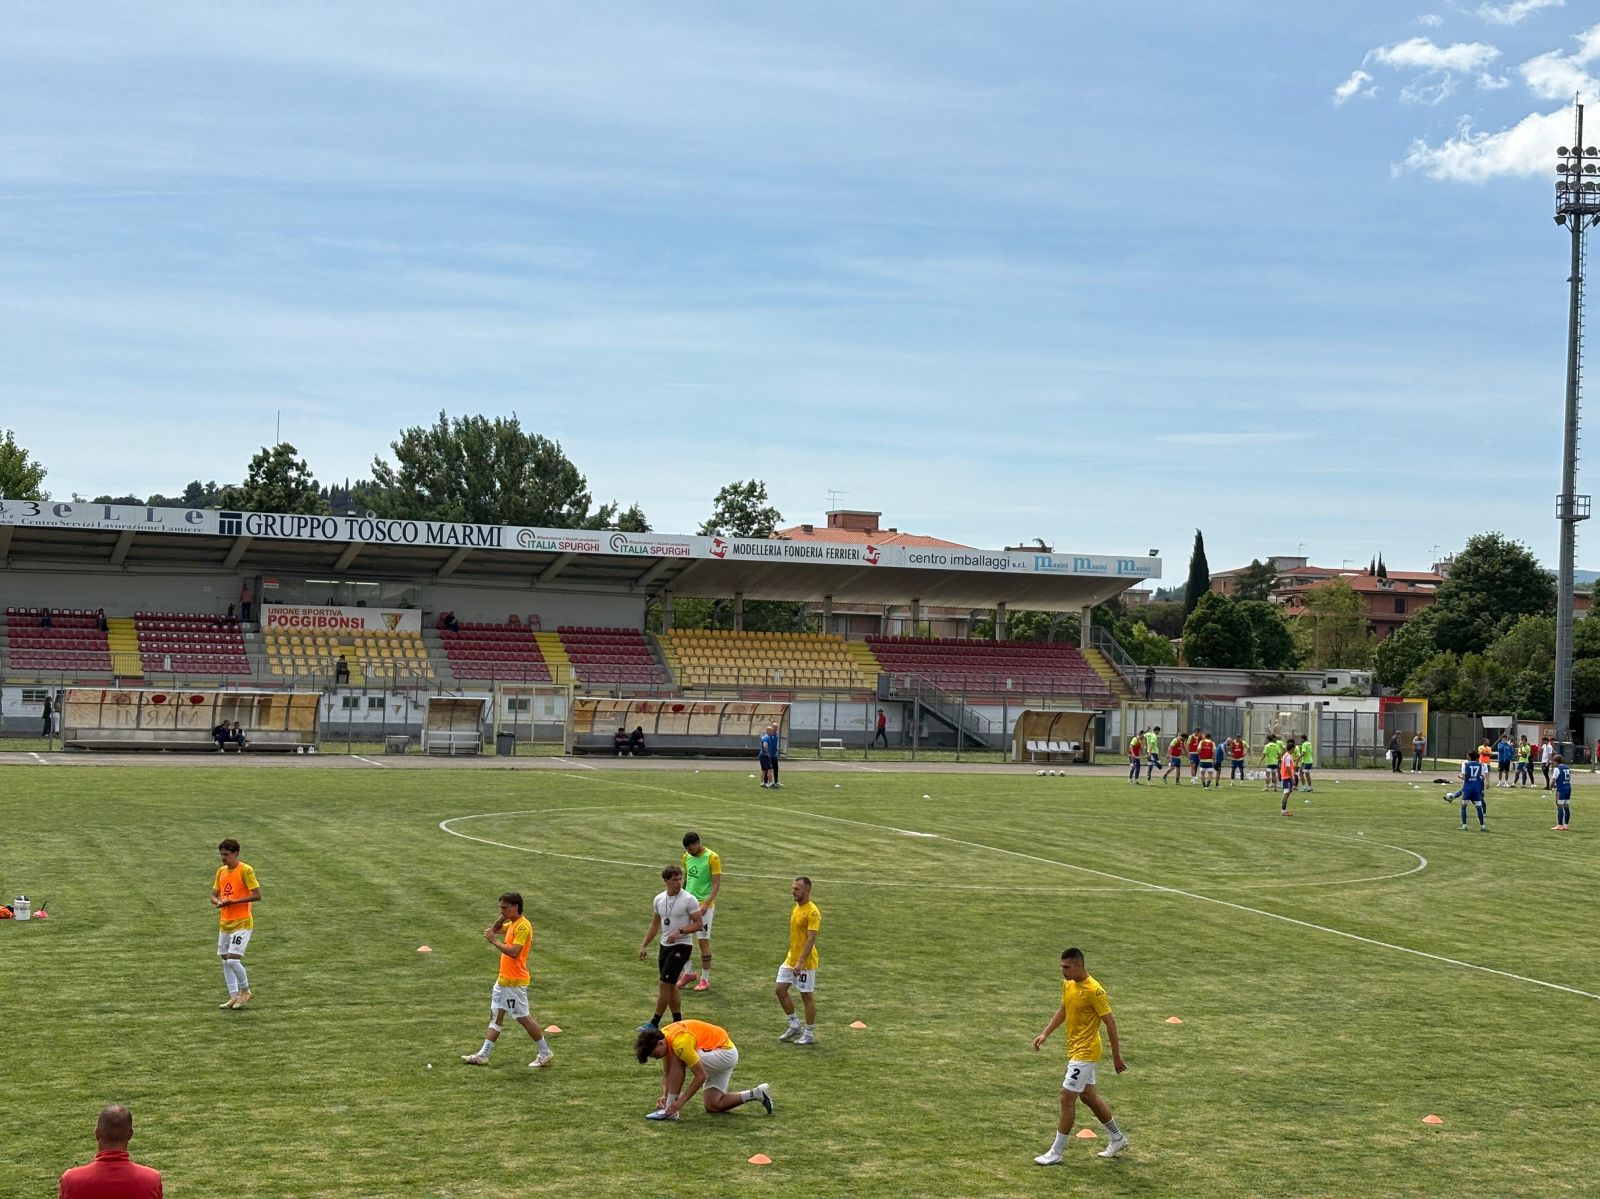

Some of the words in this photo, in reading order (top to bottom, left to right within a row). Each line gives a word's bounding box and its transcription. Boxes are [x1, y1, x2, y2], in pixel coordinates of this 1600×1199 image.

[21, 517, 57, 526] Centro
[59, 519, 95, 528] Servizi
[245, 513, 338, 539] GRUPPO
[345, 519, 419, 543] TOSCO
[426, 523, 503, 547] MARMI
[527, 540, 557, 550] ITALIA
[558, 541, 600, 552] SPURGHI
[620, 544, 648, 554] ITALIA
[650, 546, 690, 556] SPURGHI
[732, 543, 782, 557] MODELLERIA
[784, 545, 823, 558] FONDERIA
[826, 548, 860, 560] FERRIERI
[908, 553, 947, 565] centro
[950, 553, 1010, 570] imballaggi
[1012, 561, 1027, 569] s.r.l.
[302, 608, 343, 616] SPORTIVA
[267, 614, 365, 629] POGGIBONSI
[1469, 765, 1480, 777] 17
[231, 935, 242, 945] 16
[506, 998, 516, 1009] 17
[1070, 1067, 1081, 1081] 2
